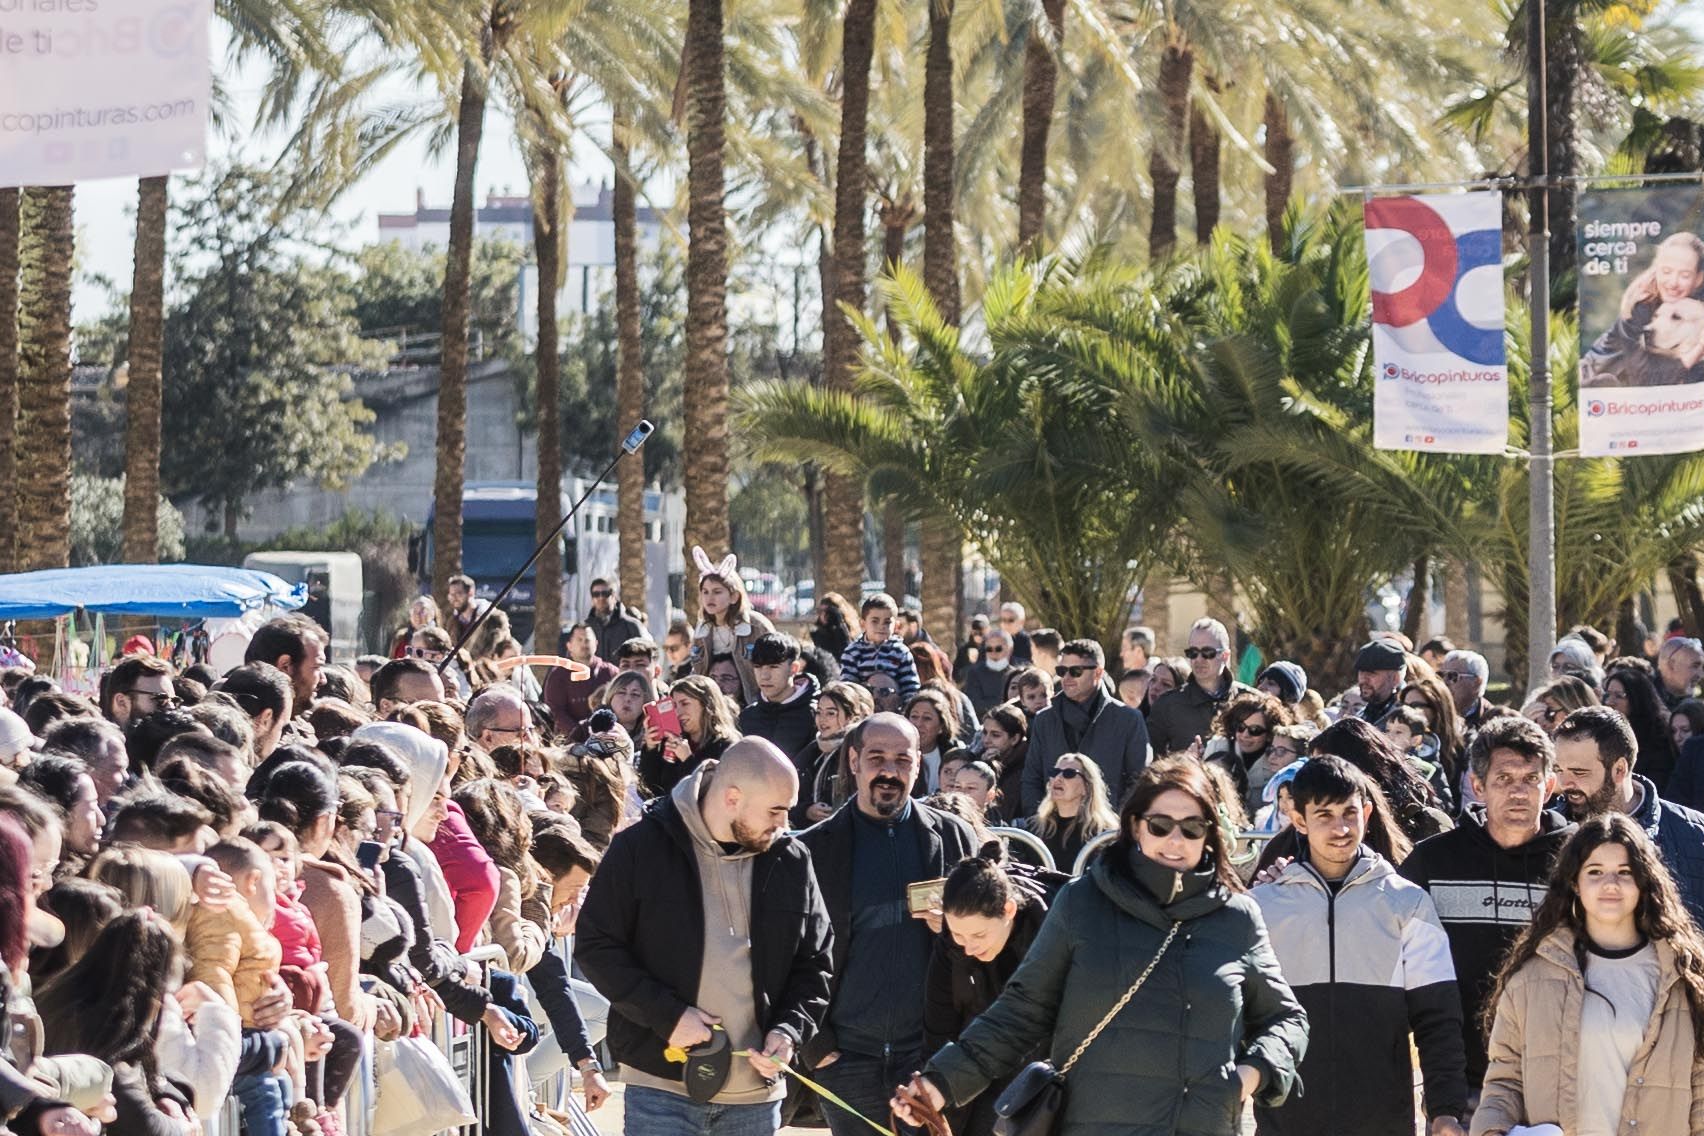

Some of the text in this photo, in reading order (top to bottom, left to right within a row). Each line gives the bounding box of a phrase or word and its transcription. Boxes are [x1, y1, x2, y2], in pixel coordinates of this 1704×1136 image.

[32, 27, 52, 54] ti
[1584, 220, 1661, 239] siempre
[1584, 241, 1637, 257] cerca
[1583, 256, 1628, 275] de ti
[1401, 368, 1501, 385] Bricopinturas
[1607, 400, 1704, 415] Bricopinturas
